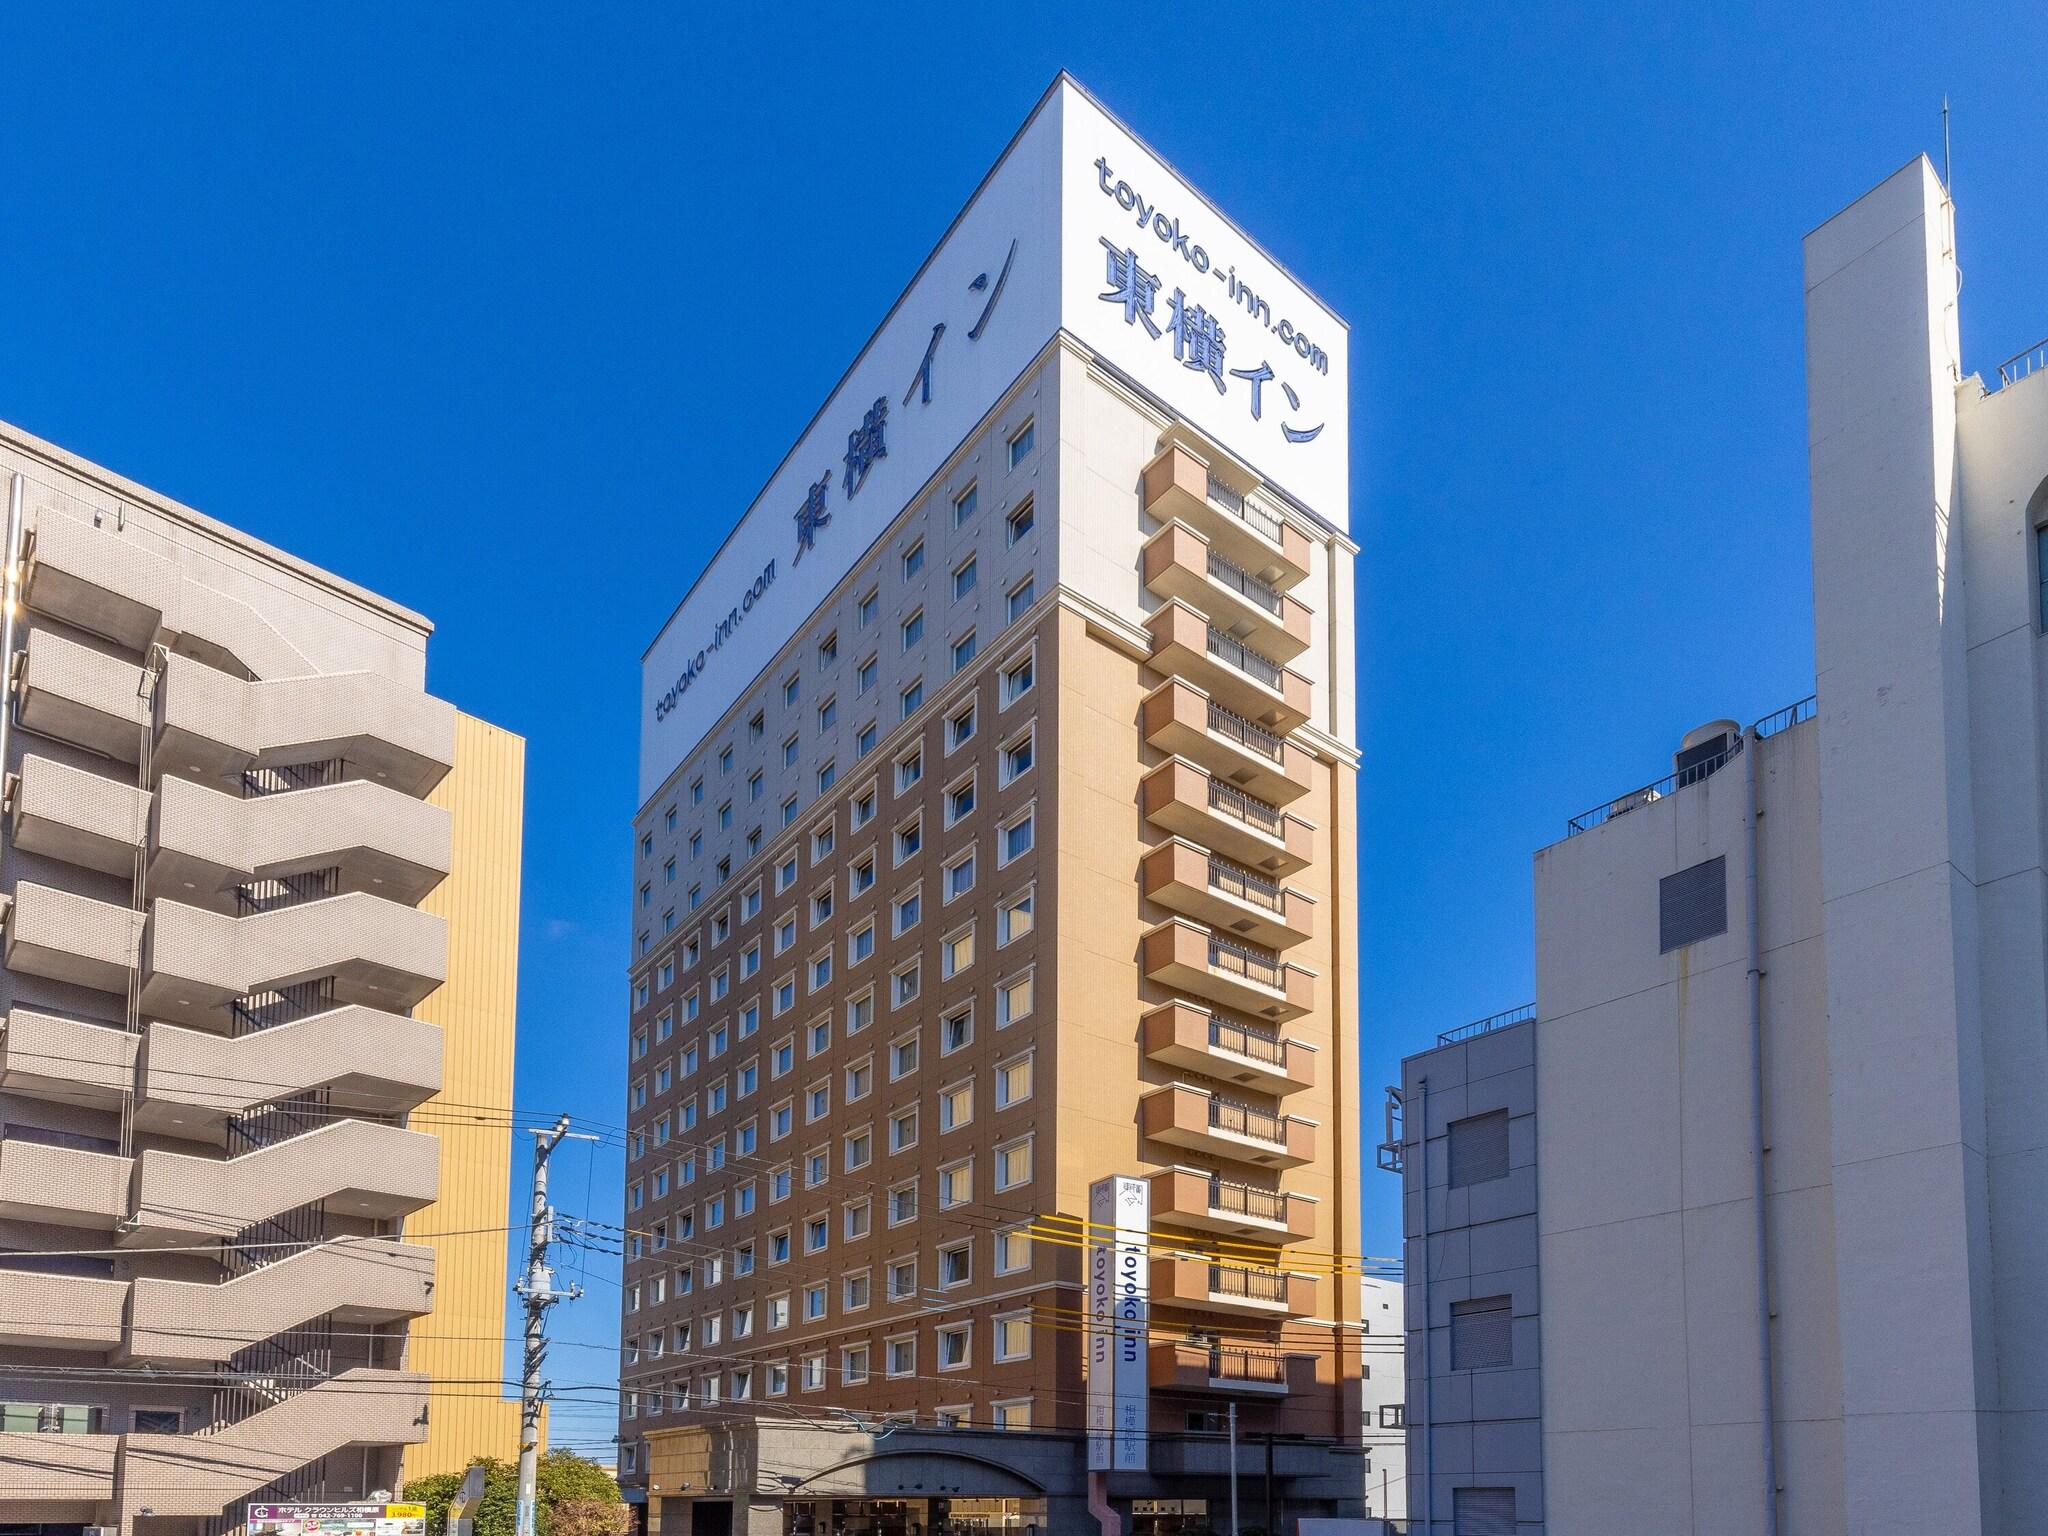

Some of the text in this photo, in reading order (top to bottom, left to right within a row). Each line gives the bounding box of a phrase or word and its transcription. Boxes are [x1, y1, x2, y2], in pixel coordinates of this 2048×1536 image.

[1094, 156, 1329, 376] toyoko-inn.com
[1098, 235, 1325, 443] 東横イン
[655, 558, 777, 722] toyoko-inn.com
[1094, 1247, 1108, 1322] toyoko
[1121, 1246, 1141, 1362] toyoko inn
